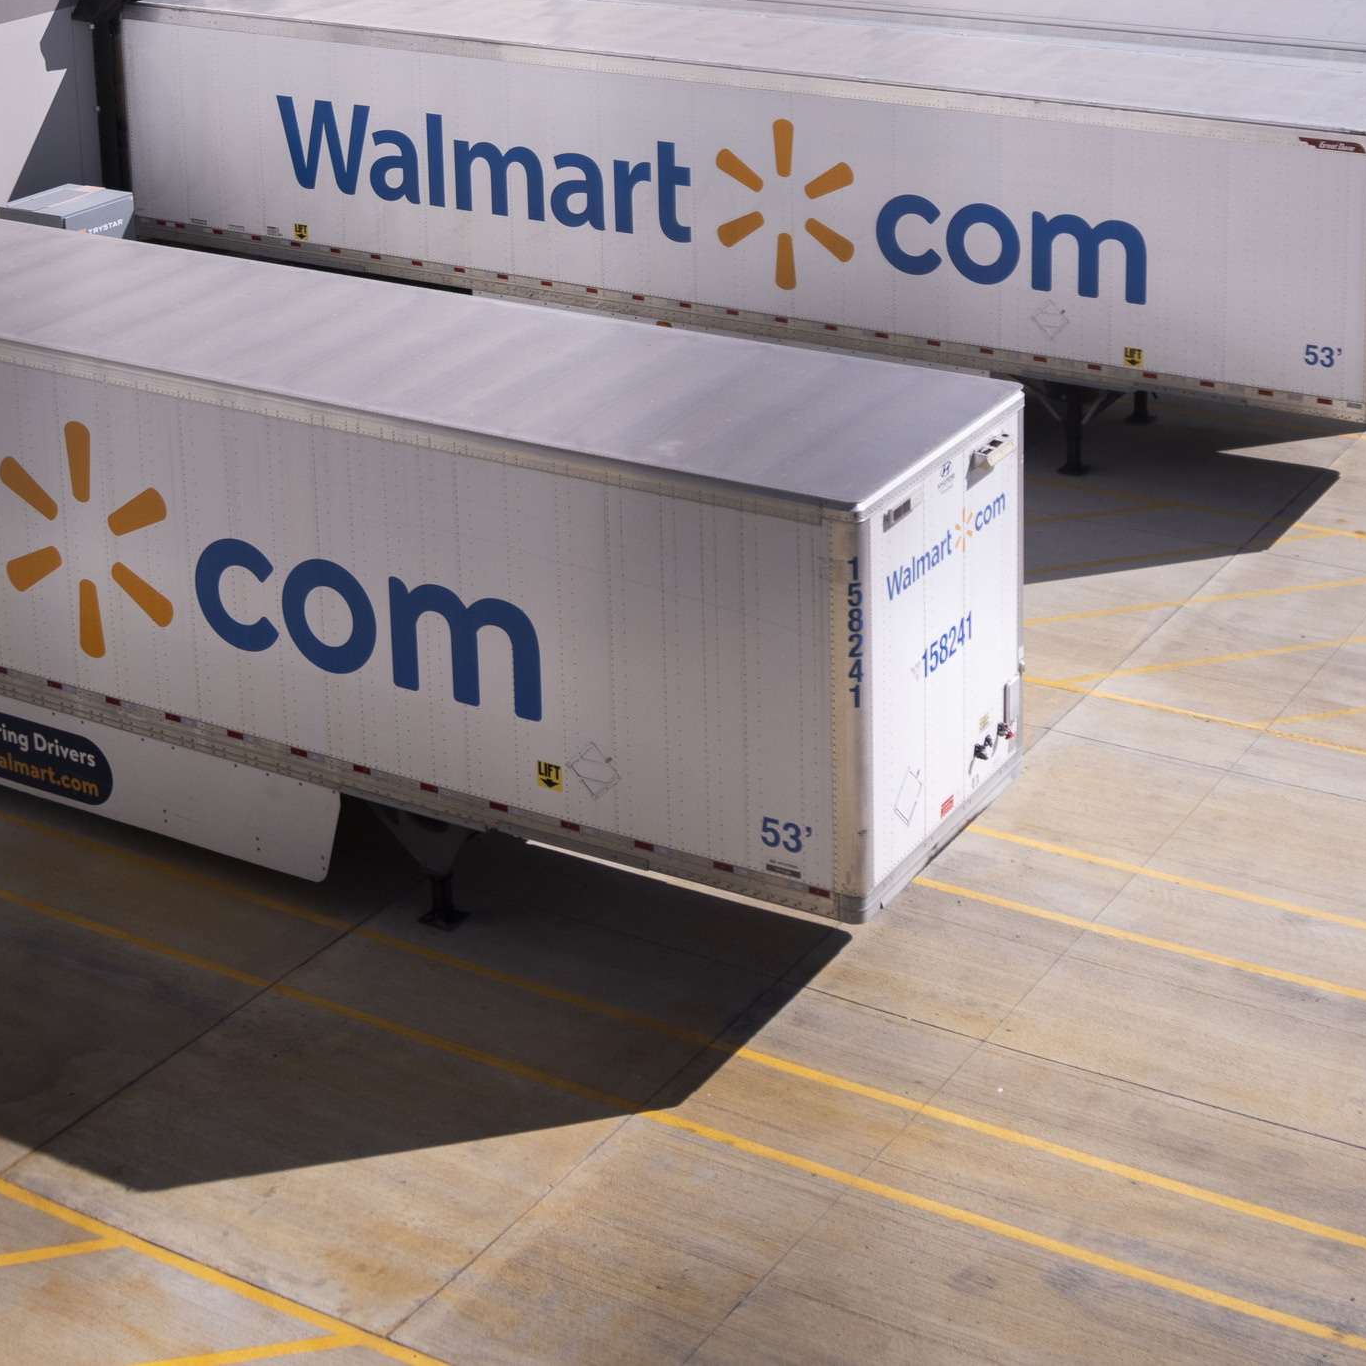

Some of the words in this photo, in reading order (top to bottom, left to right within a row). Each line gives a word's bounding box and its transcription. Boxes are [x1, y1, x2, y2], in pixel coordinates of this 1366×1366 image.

[1319, 141, 1338, 150] Great
[1338, 142, 1356, 152] Dane
[276, 95, 691, 243] Walmart
[876, 194, 1147, 305] com
[88, 218, 123, 234] TRYSTAR
[1124, 347, 1142, 360] LIFT
[1304, 344, 1342, 368] 53'
[886, 530, 952, 600] Walmart
[975, 493, 1006, 531] com
[195, 538, 541, 721] com
[847, 556, 864, 708] 158241
[922, 610, 972, 678] 158241
[33, 732, 96, 767] Drivers
[537, 760, 561, 780] LIFT
[761, 816, 813, 853] 53'
